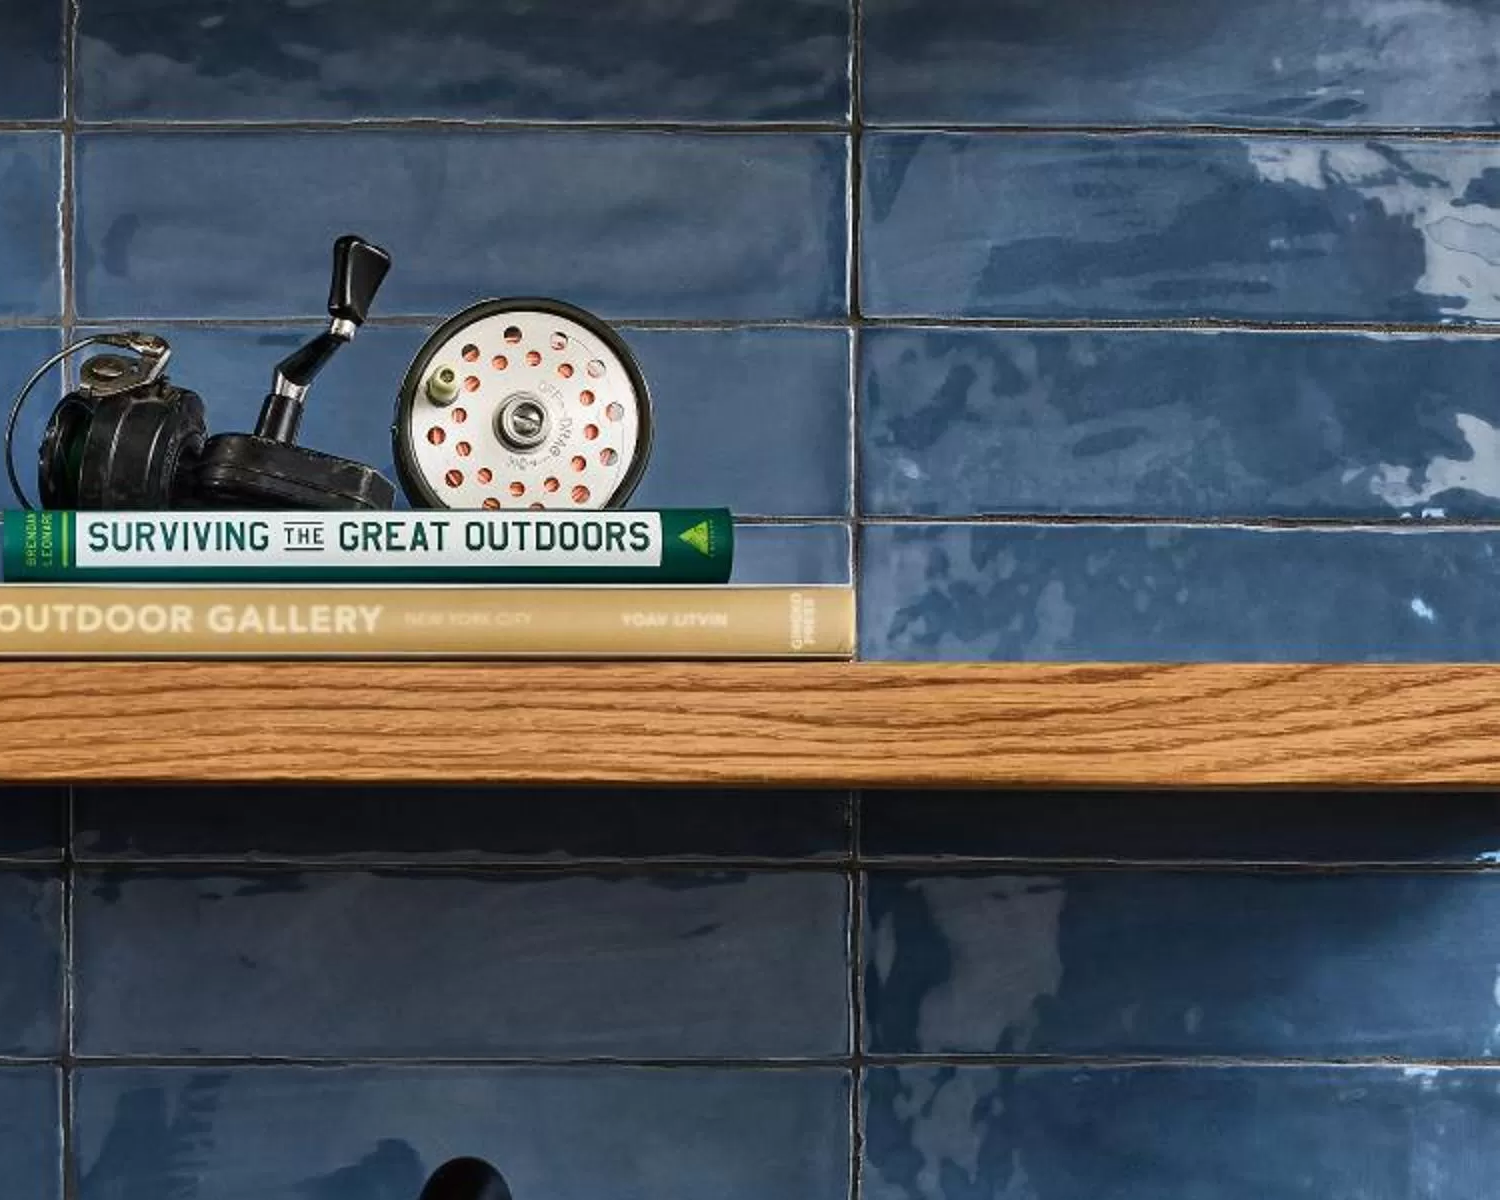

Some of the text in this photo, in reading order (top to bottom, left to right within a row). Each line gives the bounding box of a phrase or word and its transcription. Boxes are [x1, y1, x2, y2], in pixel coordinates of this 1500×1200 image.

[88, 521, 652, 552] SURVIVING THE GREAT OUTDOORS
[206, 603, 384, 634] GALLERY
